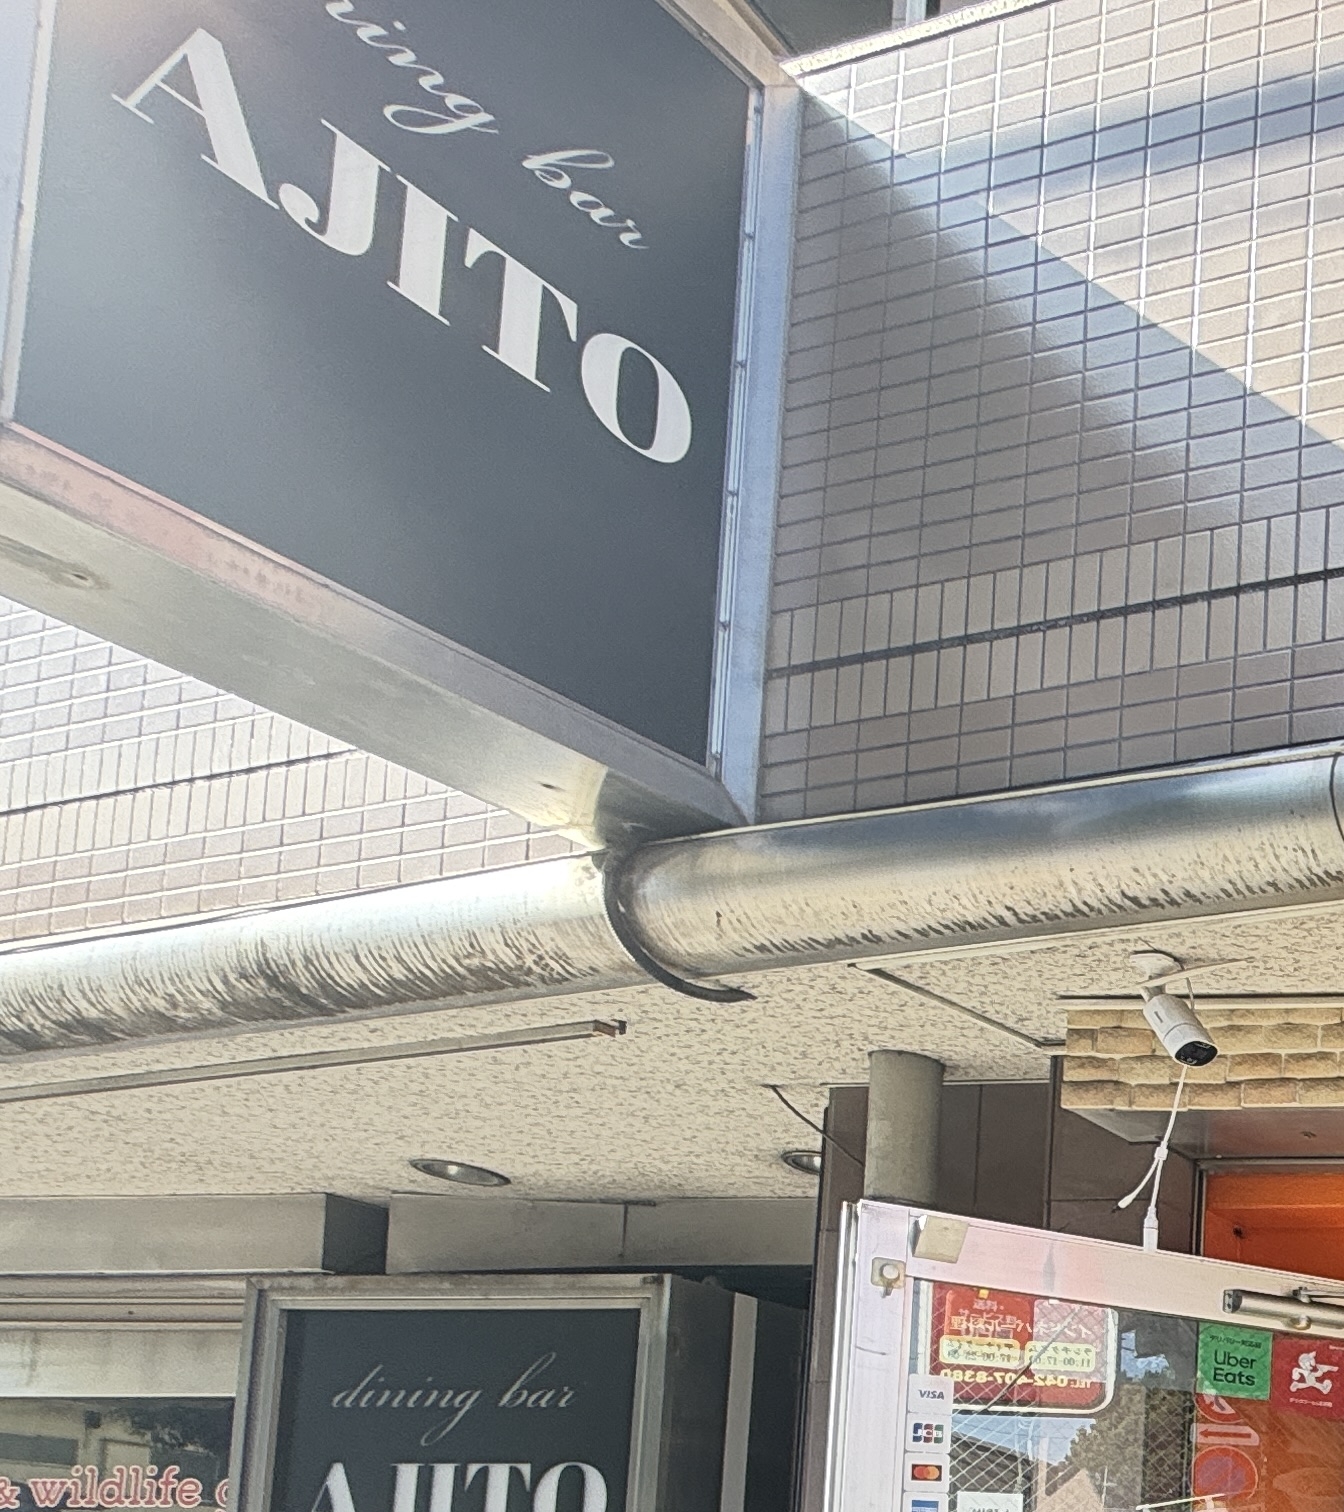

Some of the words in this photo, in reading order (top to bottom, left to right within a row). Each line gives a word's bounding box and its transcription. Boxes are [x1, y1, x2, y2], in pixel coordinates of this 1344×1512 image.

[522, 149, 648, 250] bar
[112, 27, 693, 464] AJITO
[1213, 1367, 1256, 1387] Eats
[1214, 1350, 1256, 1370] Uber
[331, 1363, 481, 1447] dining
[498, 1352, 578, 1411] bar
[919, 1390, 945, 1401] VISA
[28, 1465, 203, 1508] wildlife
